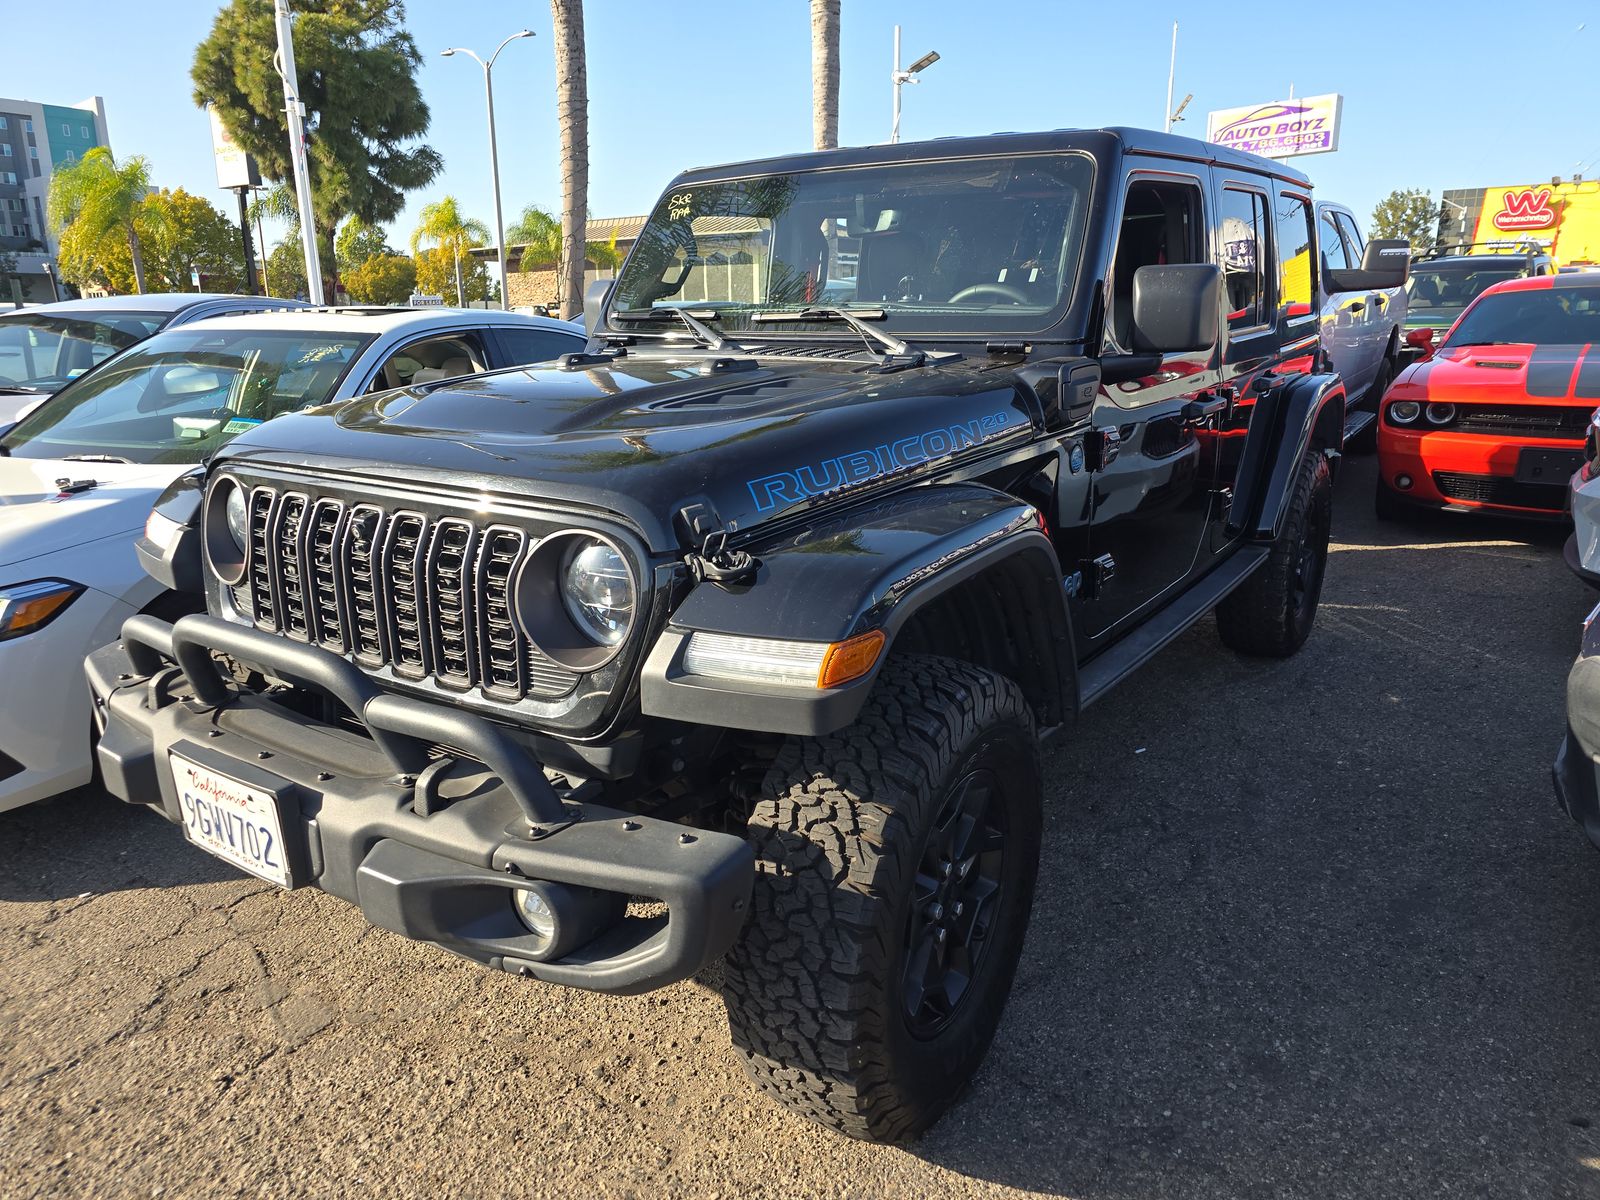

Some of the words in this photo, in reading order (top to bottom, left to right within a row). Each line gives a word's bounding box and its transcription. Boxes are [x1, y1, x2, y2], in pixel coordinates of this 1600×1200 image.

[1221, 125, 1271, 142] AUTO
[1275, 118, 1327, 134] BOYZ
[746, 419, 985, 512] RUBICON
[191, 771, 248, 808] California
[184, 792, 279, 869] 9GWV702
